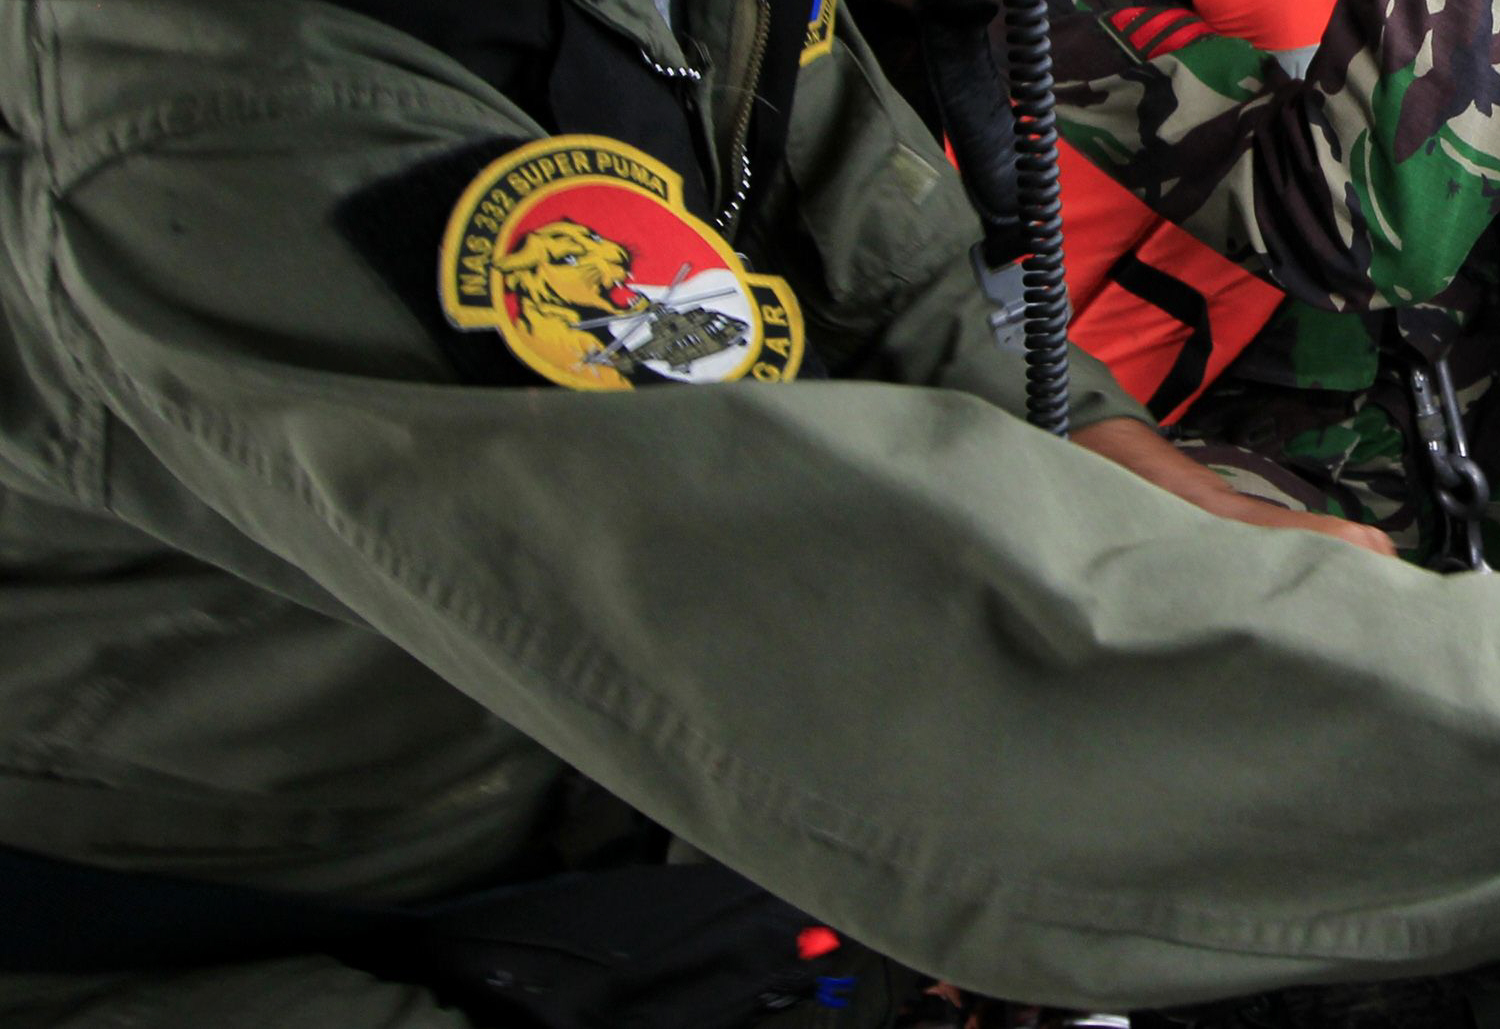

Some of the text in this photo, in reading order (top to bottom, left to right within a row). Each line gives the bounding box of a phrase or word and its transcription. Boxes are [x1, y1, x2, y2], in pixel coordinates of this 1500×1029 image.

[458, 149, 669, 296] NAS 332 SUPER PUMA
